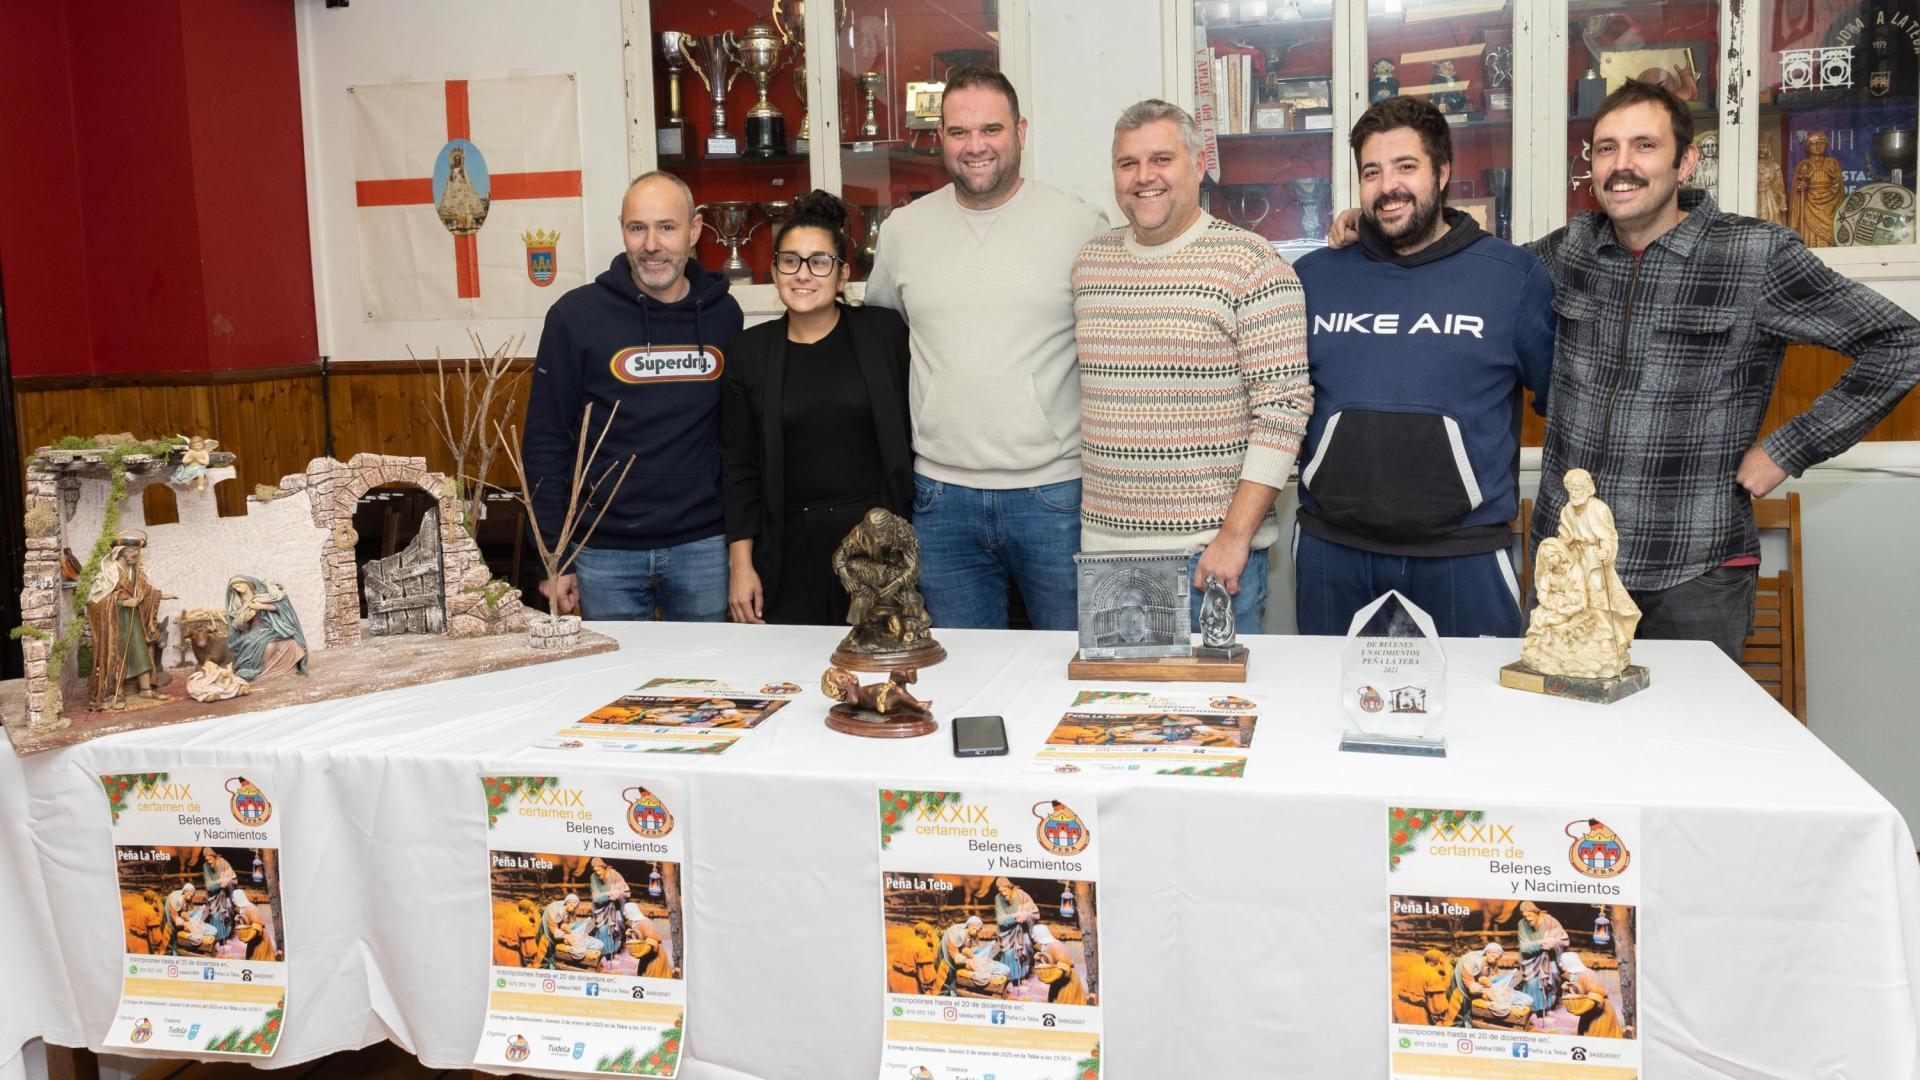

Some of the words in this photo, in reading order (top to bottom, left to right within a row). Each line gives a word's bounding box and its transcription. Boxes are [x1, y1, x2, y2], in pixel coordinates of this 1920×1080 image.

[1877, 11, 1884, 25] A
[1890, 11, 1909, 28] LA
[1313, 312, 1400, 335] NIKE
[1408, 312, 1484, 339] AIR
[1362, 656, 1383, 664] PEÑA
[135, 784, 193, 800] XXXIX
[519, 788, 584, 807] XXXIX
[137, 801, 184, 812] certamen
[187, 801, 200, 812] de
[519, 807, 573, 819] certamen
[577, 809, 593, 820] de
[178, 814, 221, 825] Belenes
[917, 804, 989, 824] XXXIX
[195, 831, 200, 841] y
[204, 829, 267, 841] Nacimientos
[566, 821, 614, 835] Belenes
[916, 825, 977, 837] certamen
[982, 825, 998, 838] de
[1431, 822, 1515, 844] XXXIX
[583, 840, 590, 850] y
[594, 838, 668, 853] Nacimientos
[969, 840, 1022, 853] Belenes
[1429, 845, 1500, 859] certamen
[1505, 846, 1524, 859] de
[118, 850, 139, 861] Peña
[140, 851, 150, 861] La
[150, 851, 171, 861] Teba
[492, 856, 516, 867] Peña
[517, 857, 529, 867] La
[530, 858, 553, 870] Teba
[987, 858, 995, 870] y
[1000, 856, 1082, 872] Nacimientos
[1490, 860, 1551, 876] Belenes
[886, 878, 912, 890] Peña
[914, 879, 926, 890] La
[927, 879, 953, 891] Teba
[1511, 881, 1519, 894] y
[1525, 879, 1620, 895] Nacimientos
[1393, 901, 1423, 914] Peña
[1425, 902, 1439, 914] La
[1441, 903, 1470, 916] Teba
[497, 969, 534, 978] Inscripciones
[536, 971, 551, 979] hasta
[553, 971, 558, 979] el
[559, 973, 567, 981] 20
[568, 973, 576, 981] de
[577, 974, 606, 983] diciembre
[892, 997, 933, 1006] Inscripciones
[934, 998, 952, 1007] hasta
[954, 999, 960, 1007] el
[961, 1000, 970, 1008] 20
[981, 1001, 1012, 1010] diciembre
[168, 1026, 187, 1035] Tudela
[1398, 1027, 1445, 1038] Inscripciones
[1446, 1029, 1467, 1039] hasta
[1469, 1030, 1476, 1039] el
[1477, 1032, 1487, 1040] 20
[1489, 1032, 1498, 1041] de
[1500, 1033, 1537, 1043] diciembre
[547, 1044, 570, 1053] Tudela
